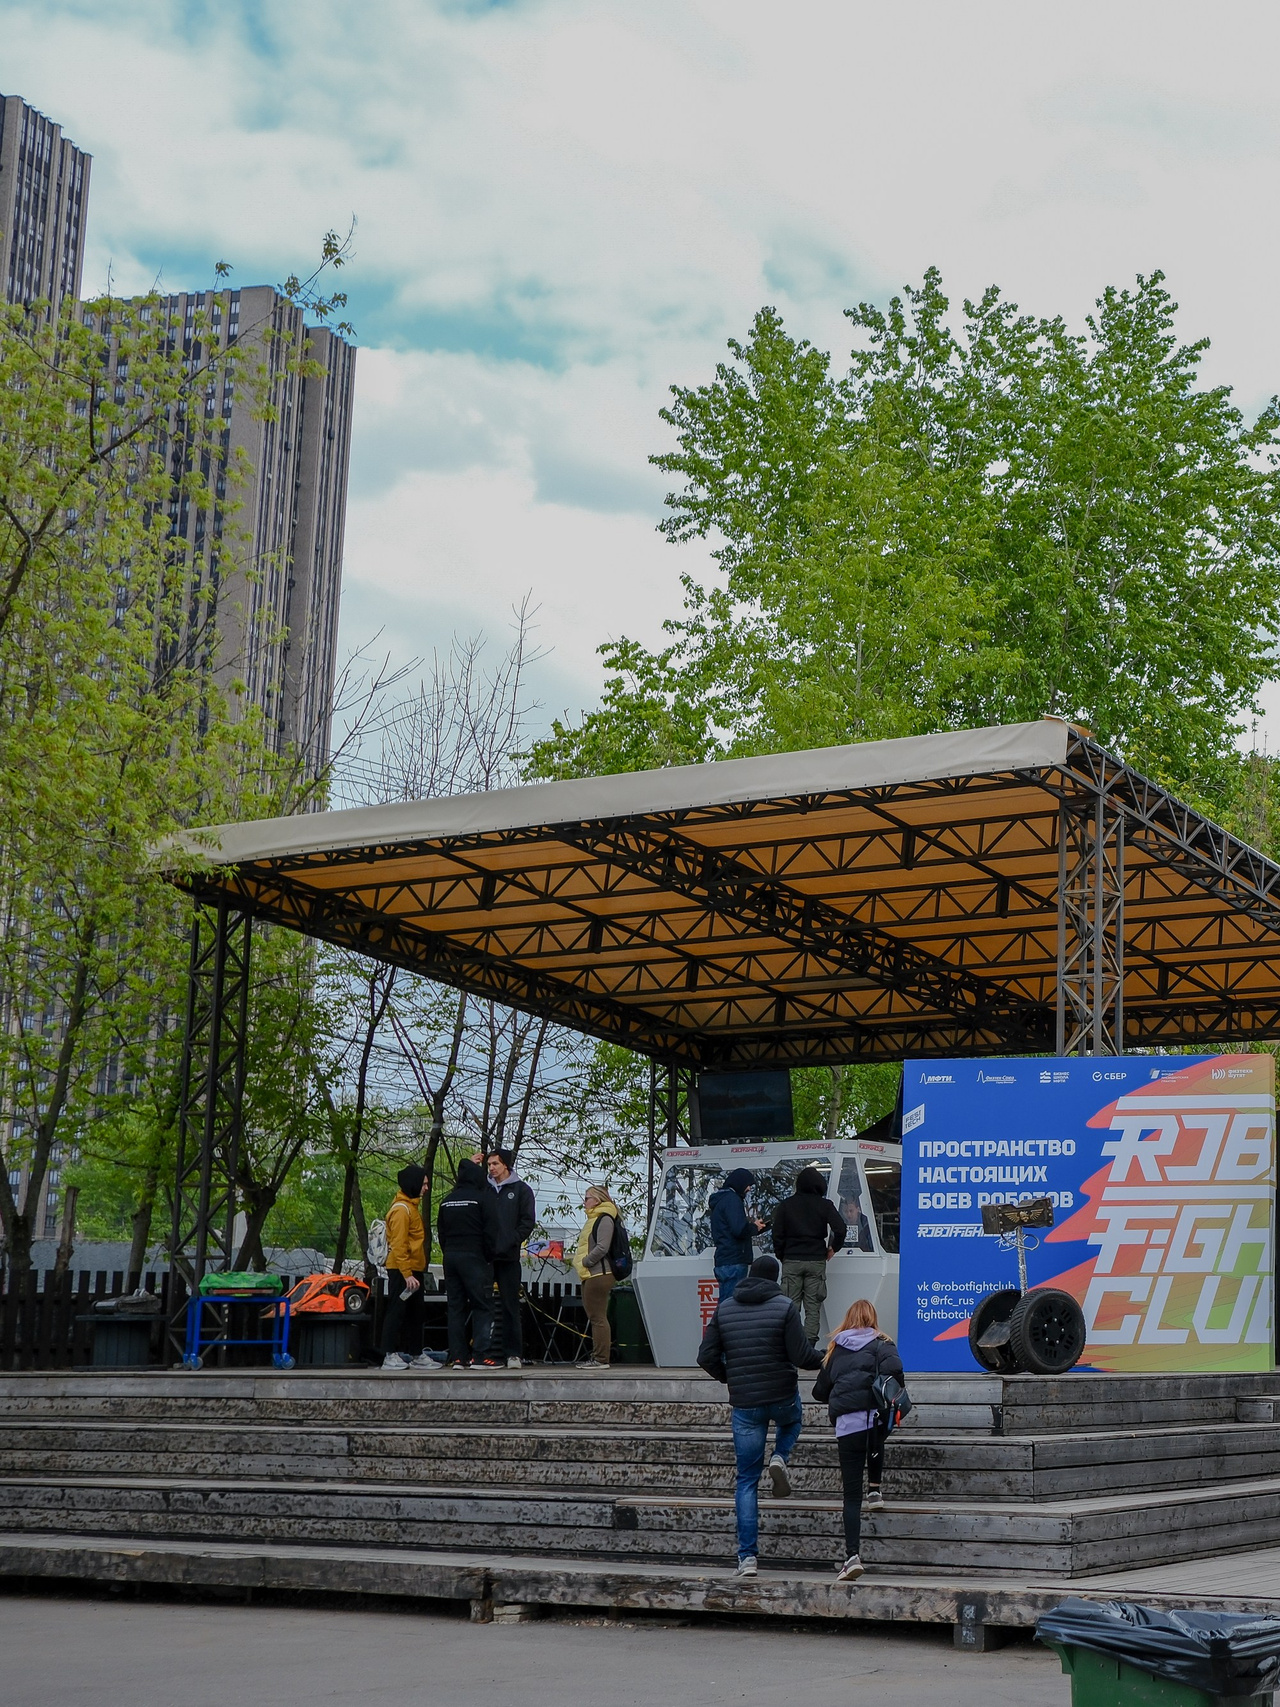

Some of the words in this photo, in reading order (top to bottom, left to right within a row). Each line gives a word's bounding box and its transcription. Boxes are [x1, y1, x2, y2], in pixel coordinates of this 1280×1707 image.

[1104, 1072, 1127, 1080] СБЕР
[919, 1139, 1076, 1158] ПРОСТРАНСТВО
[918, 1165, 1048, 1185] НАСТОЯЩИХ
[918, 1192, 972, 1209] БОЕВ
[917, 1281, 929, 1292] vk
[931, 1281, 1016, 1293] @robotfightclub
[917, 1296, 928, 1308] tg
[930, 1295, 975, 1307] @rfc_rus
